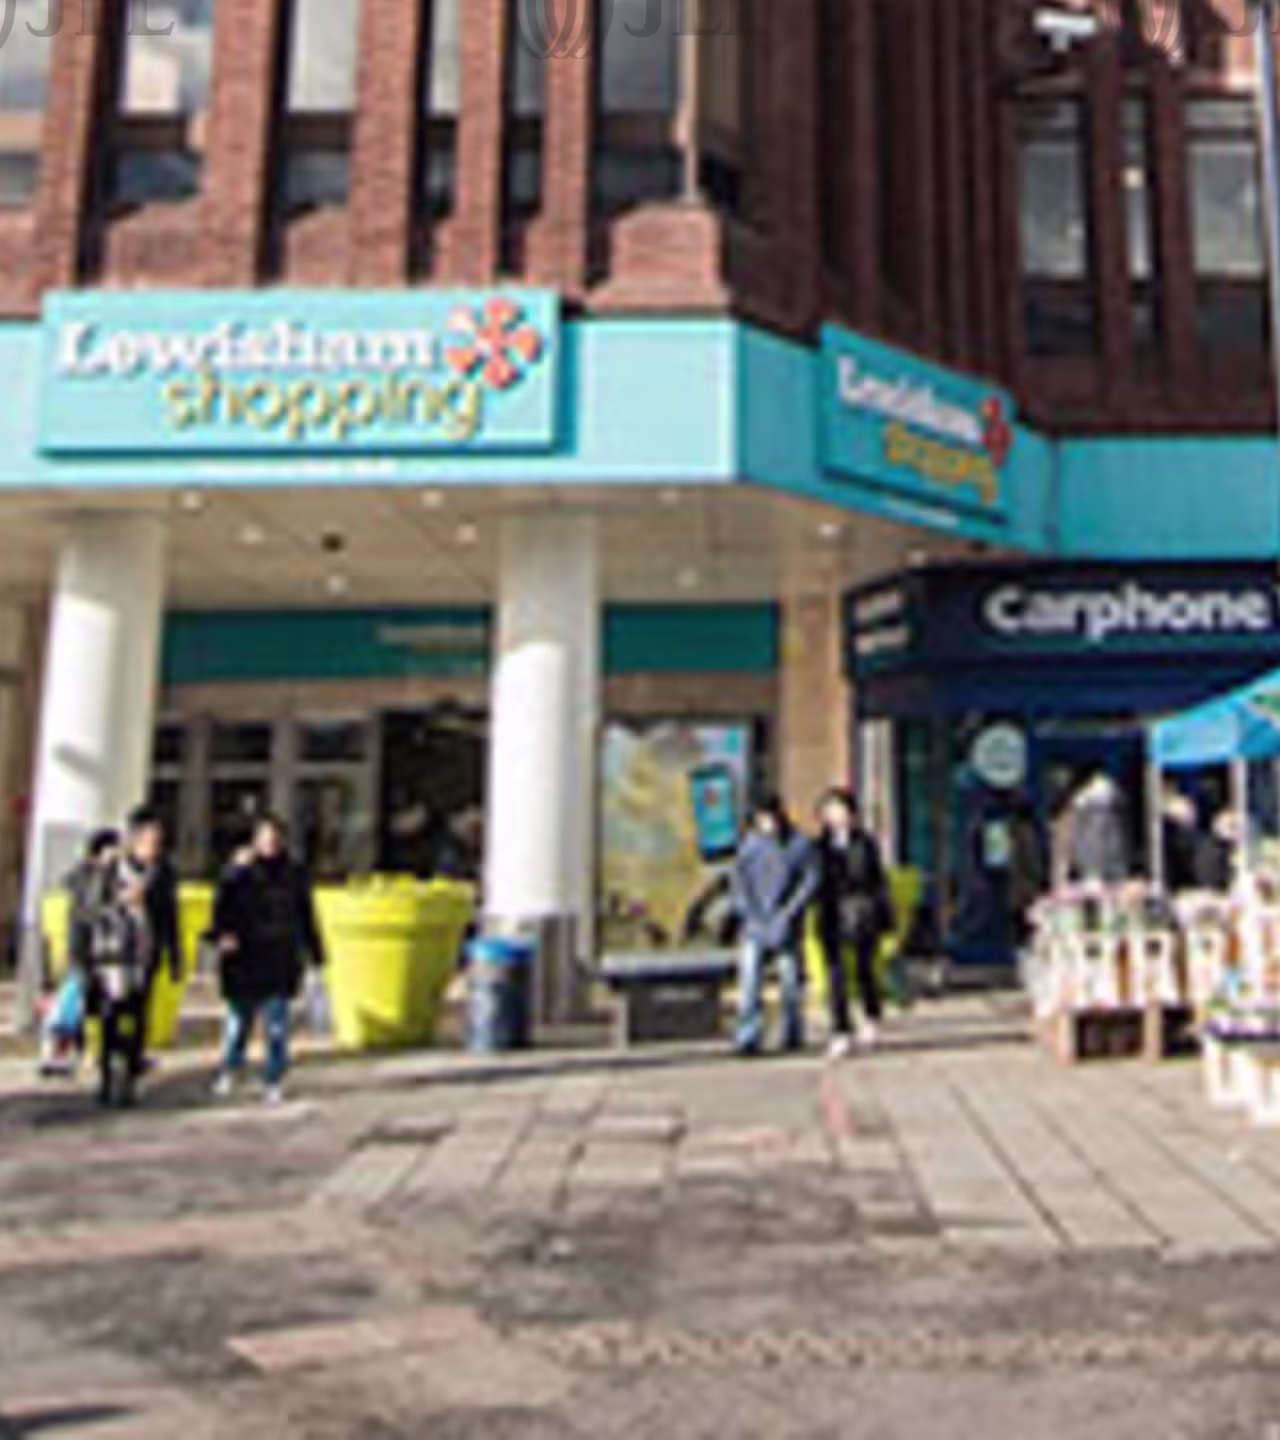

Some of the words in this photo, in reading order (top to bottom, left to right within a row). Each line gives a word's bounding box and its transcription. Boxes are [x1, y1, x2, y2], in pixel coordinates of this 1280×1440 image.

[54, 315, 440, 378] Lewisham
[161, 360, 484, 442] shopping
[985, 581, 1272, 643] Carphone
